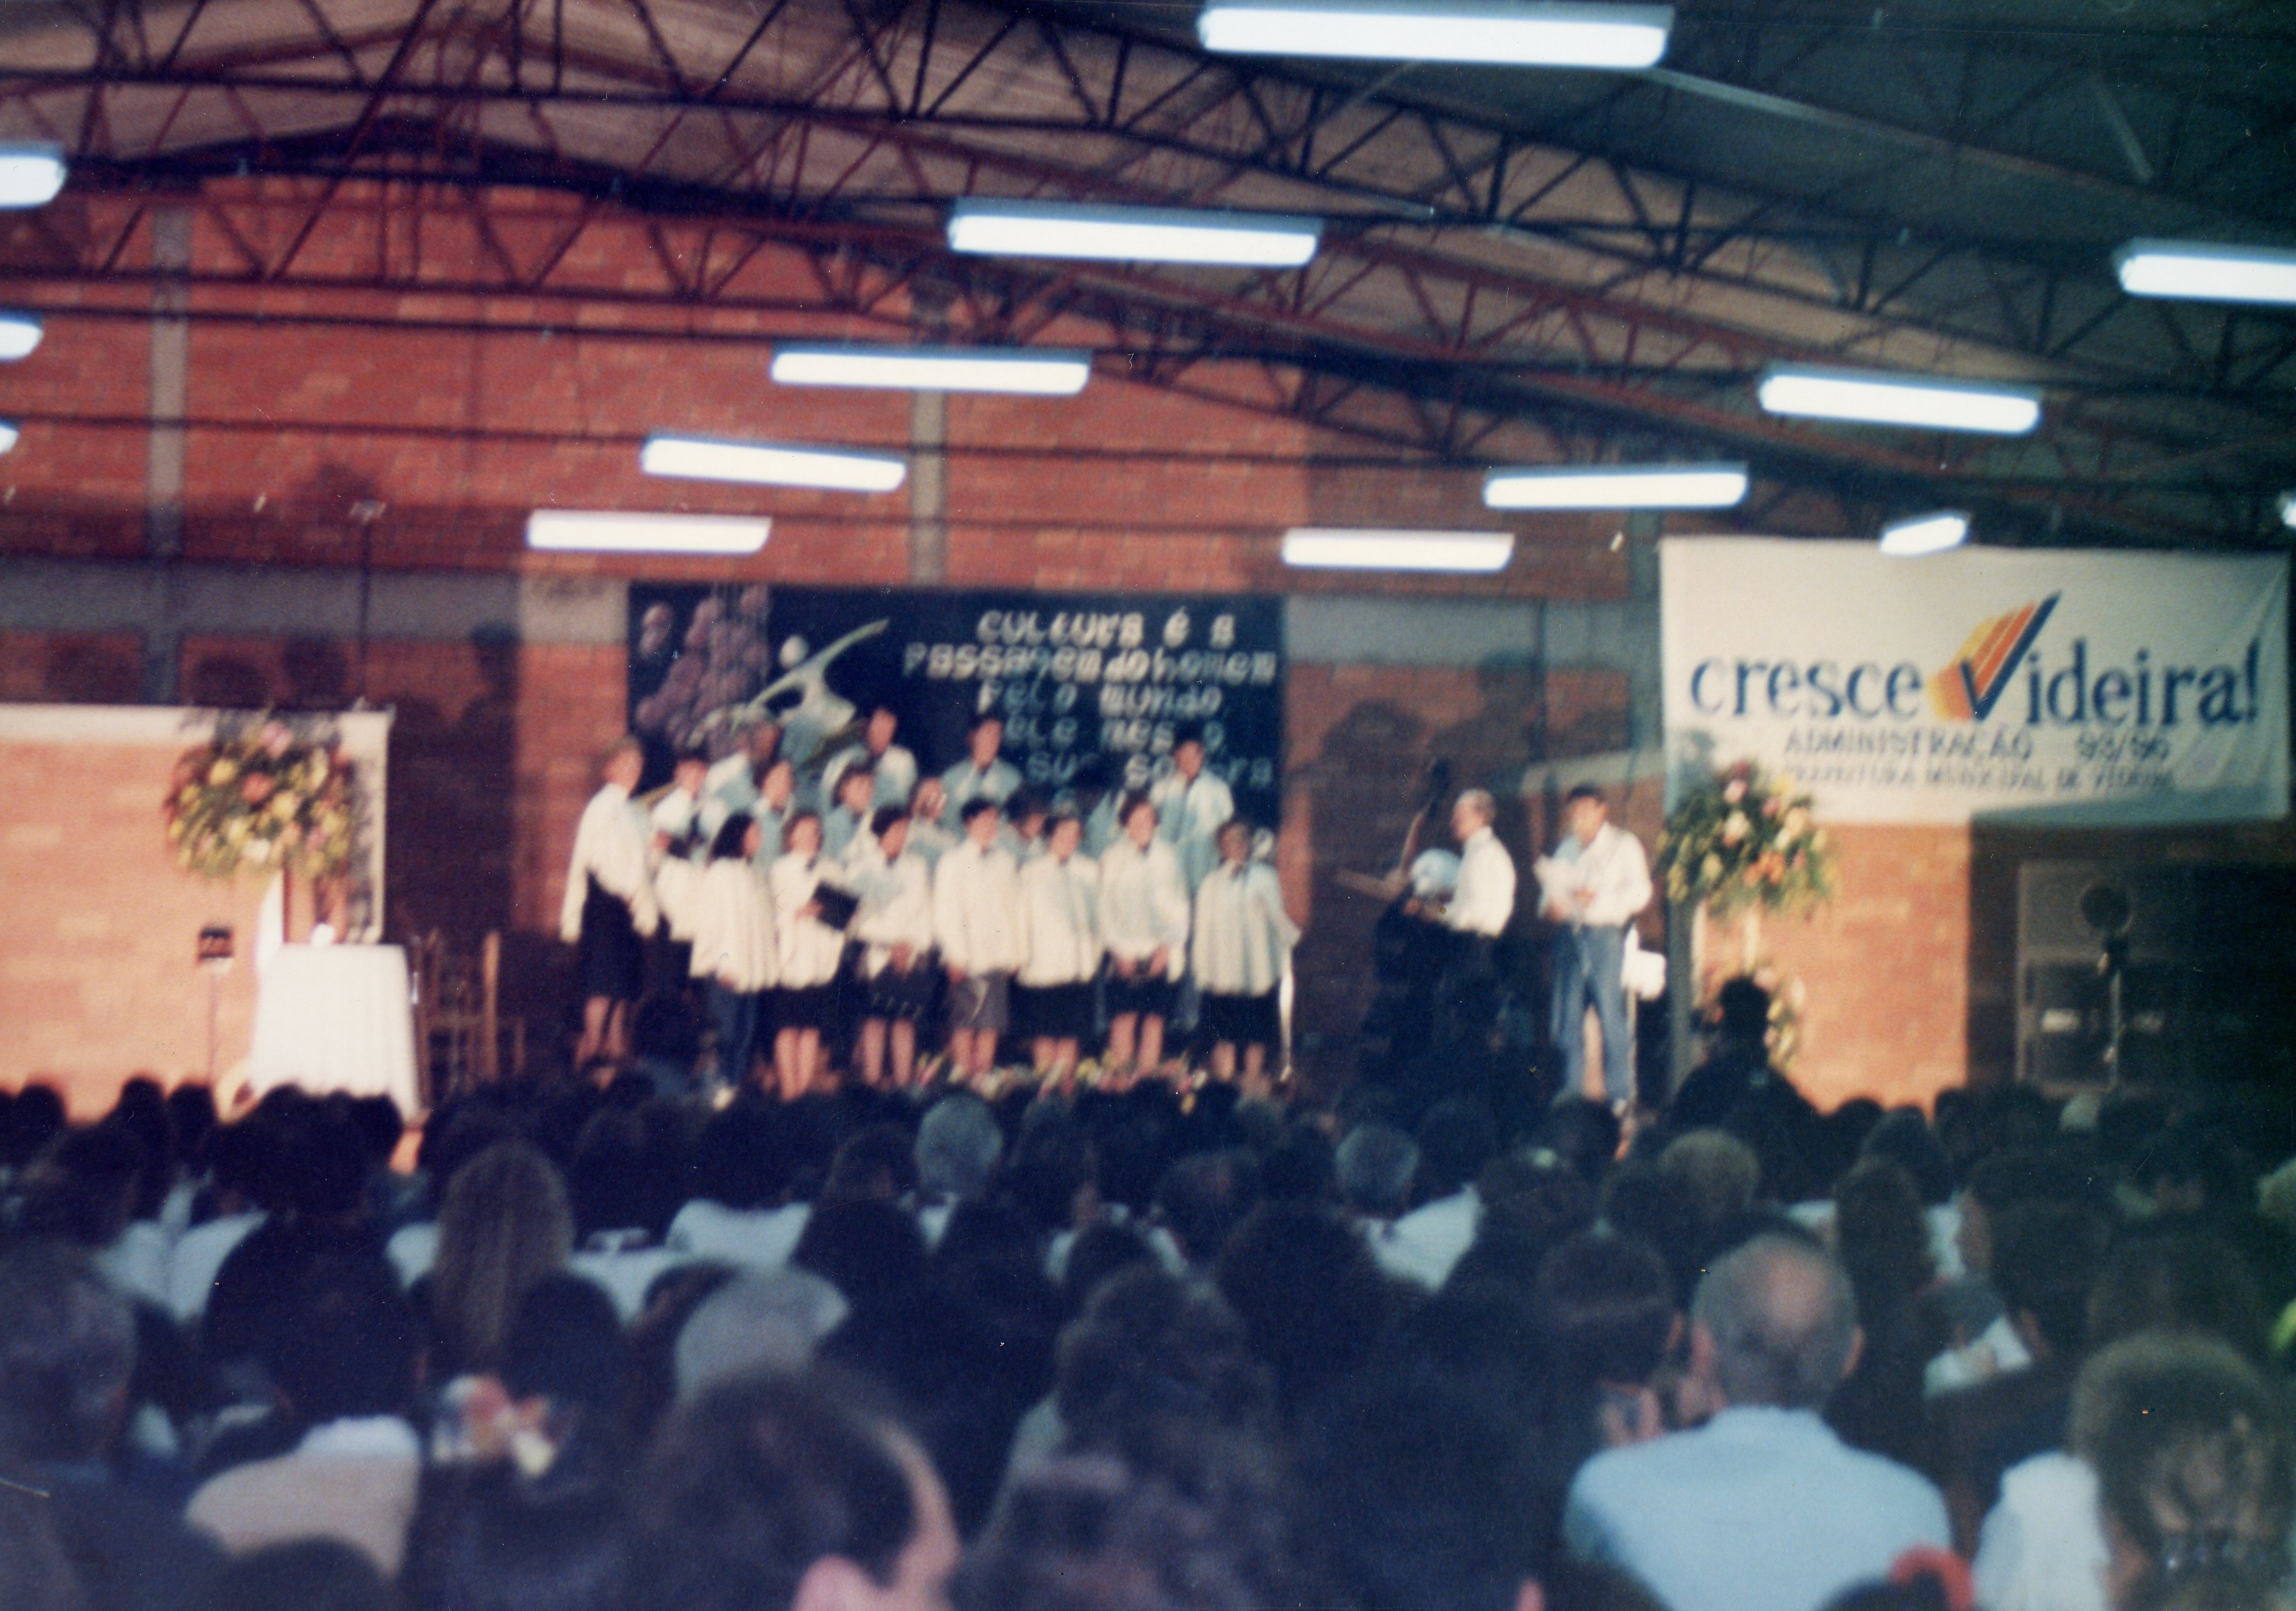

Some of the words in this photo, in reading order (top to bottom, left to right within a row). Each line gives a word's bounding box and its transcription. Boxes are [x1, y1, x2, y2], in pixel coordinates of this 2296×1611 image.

[1691, 656, 1924, 720] cresce
[1959, 590, 2259, 725] Videira!
[1099, 718, 1225, 753] meso
